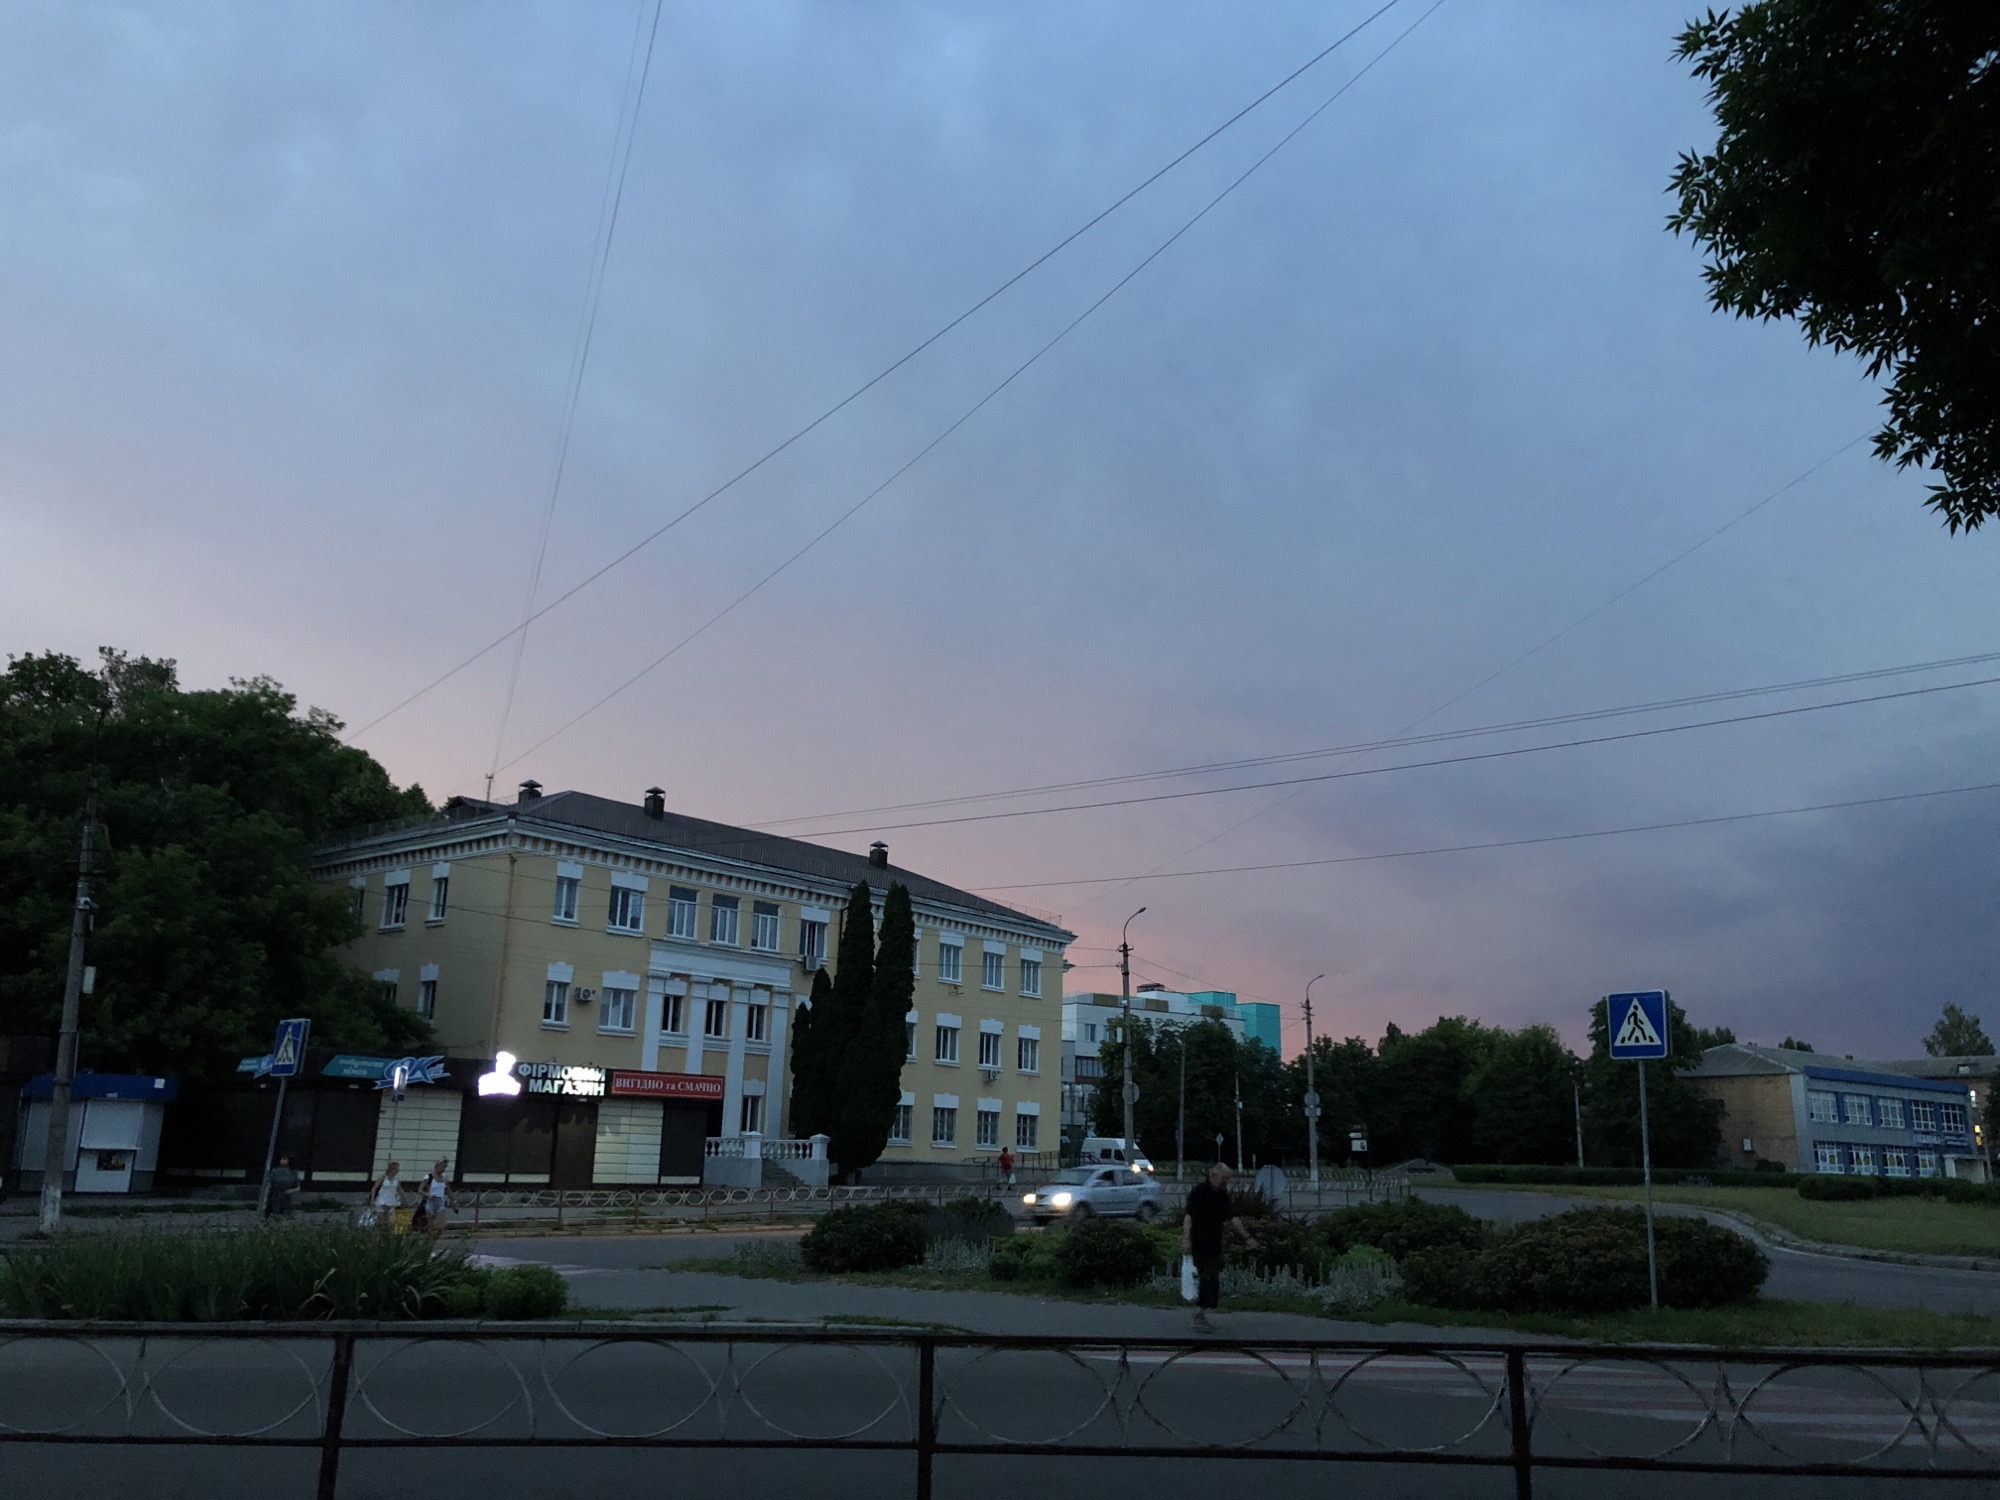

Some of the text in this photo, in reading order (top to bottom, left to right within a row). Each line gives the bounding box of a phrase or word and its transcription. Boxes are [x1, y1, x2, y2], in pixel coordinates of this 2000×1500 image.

[529, 1079, 606, 1096] МАГАЗИН
[615, 1077, 721, 1092] ВИГІДНО та СМАЧНО
